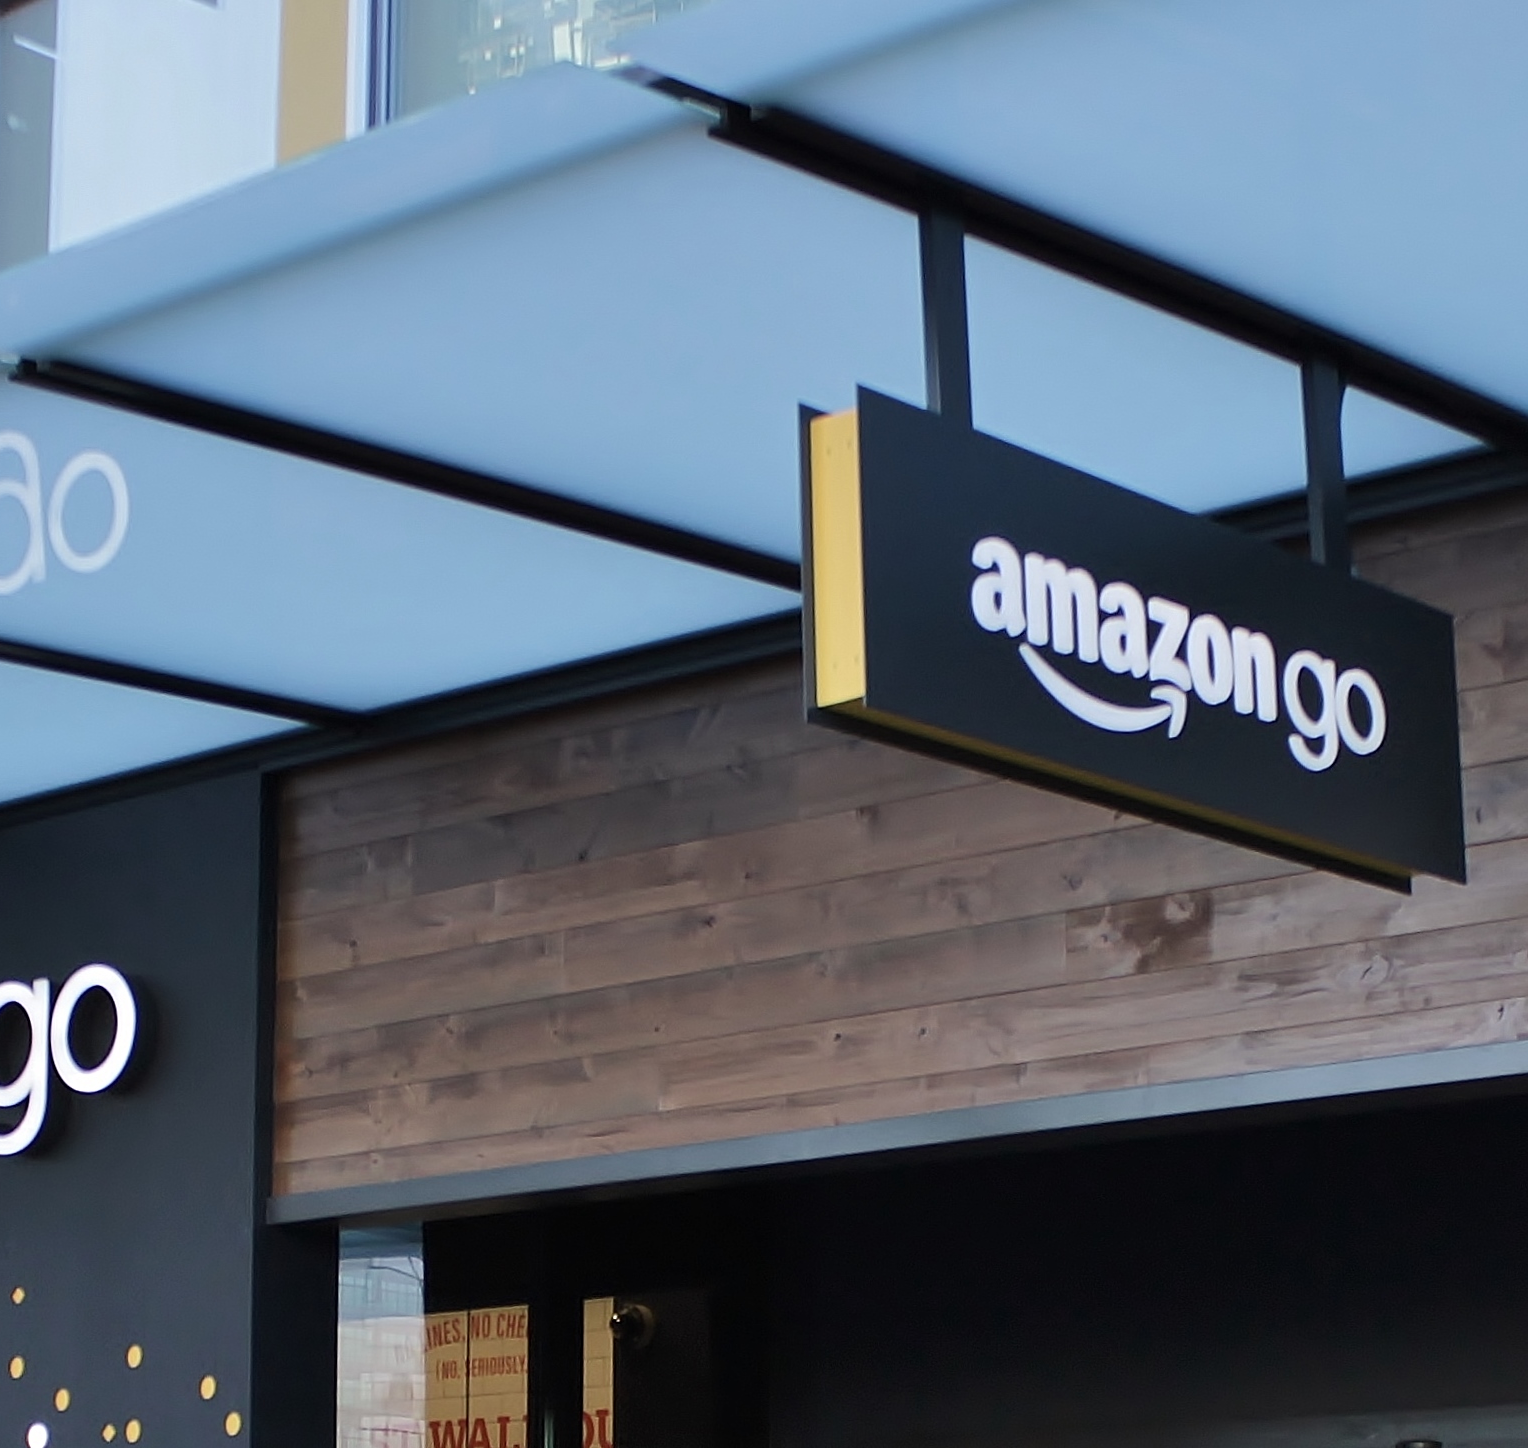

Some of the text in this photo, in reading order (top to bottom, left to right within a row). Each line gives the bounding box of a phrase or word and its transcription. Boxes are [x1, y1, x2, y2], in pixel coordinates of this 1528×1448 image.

[971, 535, 1386, 772] amazon go
[423, 1317, 465, 1353] INES.
